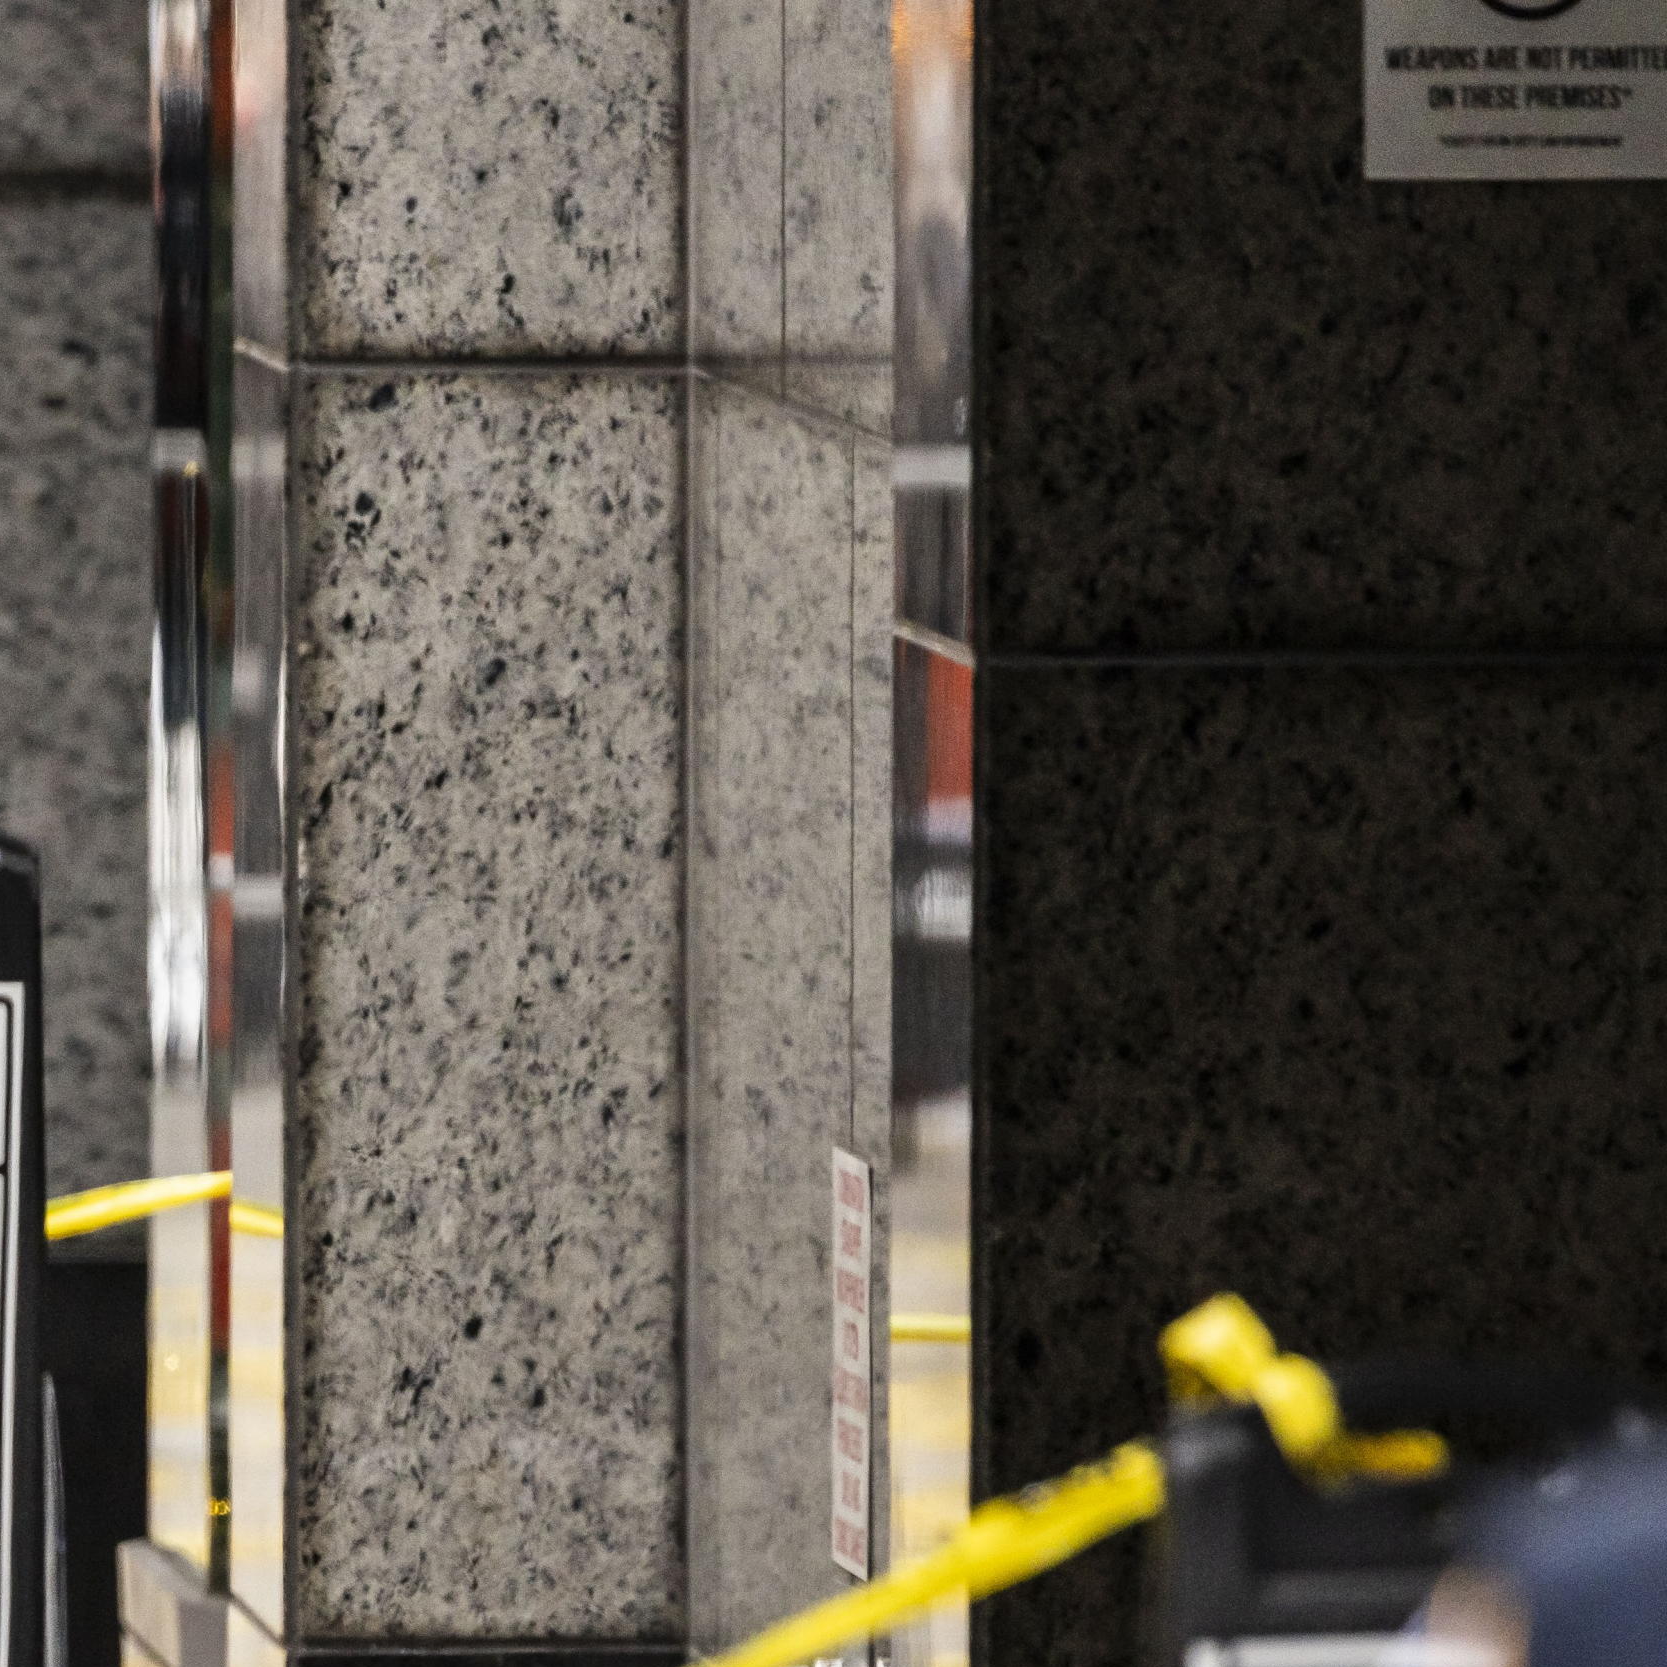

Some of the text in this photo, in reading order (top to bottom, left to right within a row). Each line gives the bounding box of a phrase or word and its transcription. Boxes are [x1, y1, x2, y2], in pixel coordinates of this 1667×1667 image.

[1384, 46, 1667, 71] WEAPONS ARE NOT PERMITTE
[1428, 85, 1456, 109] ON
[1462, 85, 1517, 109] THESE
